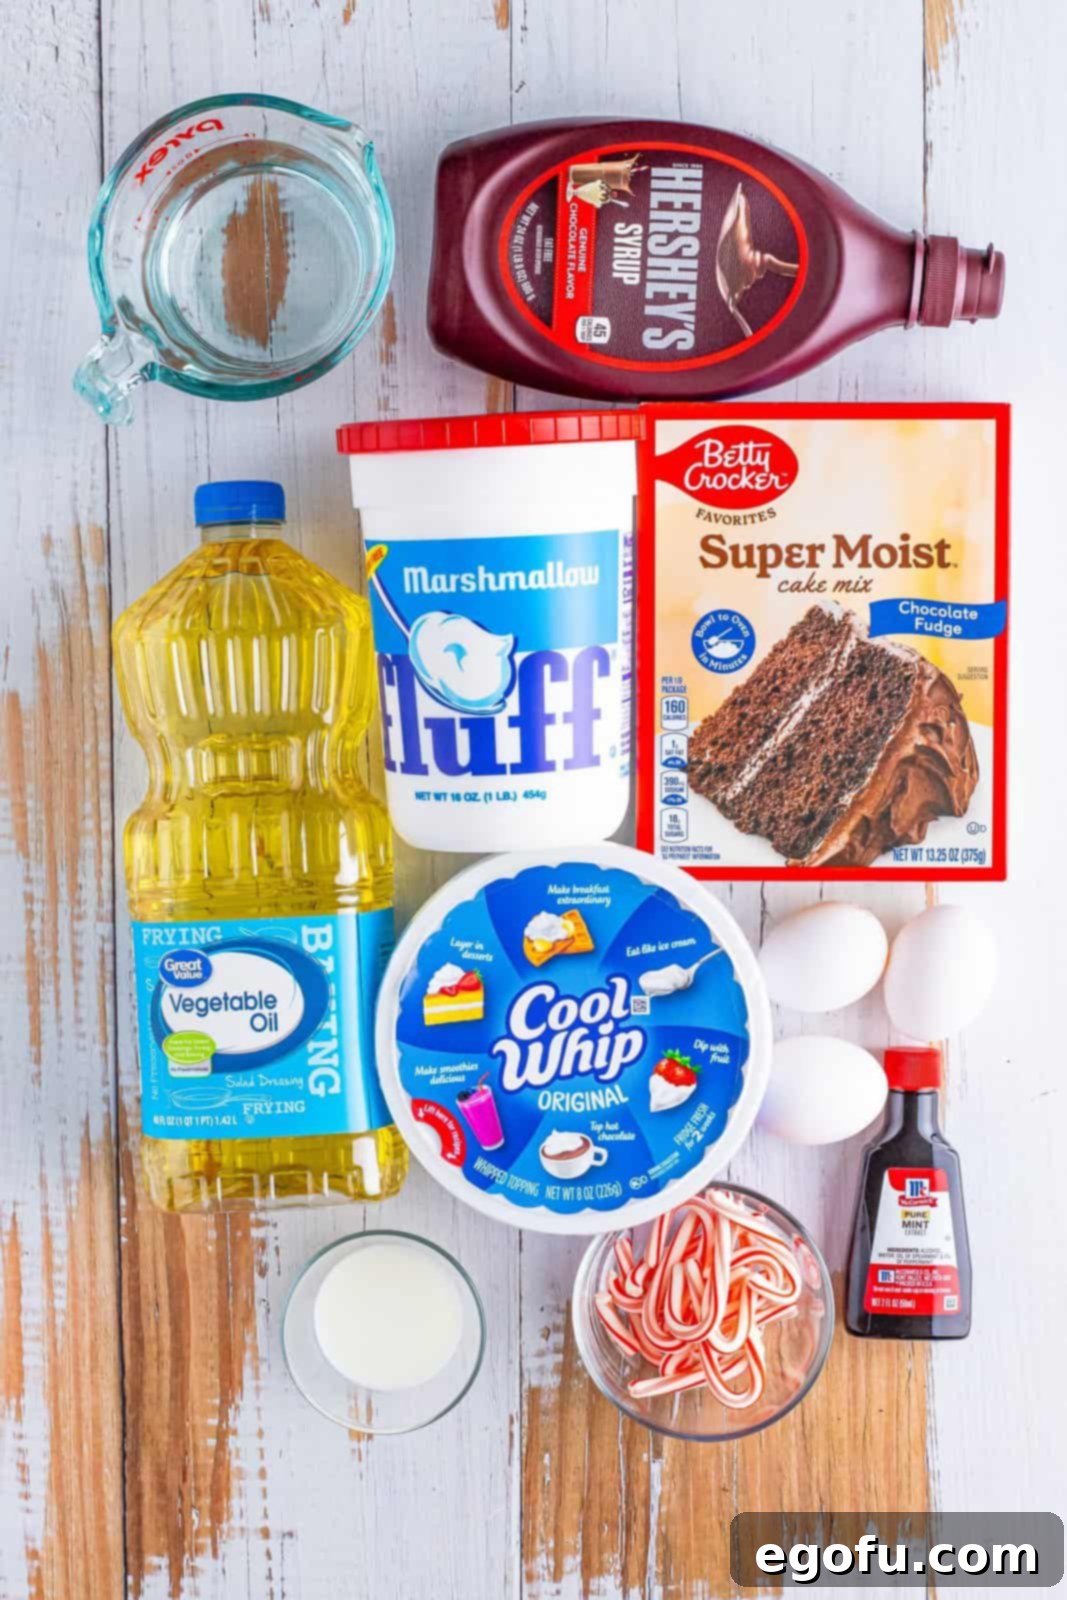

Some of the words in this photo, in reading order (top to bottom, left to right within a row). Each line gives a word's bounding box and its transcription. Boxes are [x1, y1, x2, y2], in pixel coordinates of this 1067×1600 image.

[567, 203, 578, 260] CHOCOLATE
[578, 228, 588, 272] GENUINE
[612, 222, 643, 285] SYRUP
[642, 167, 703, 350] HERSHEY'S
[566, 262, 576, 299] FLAVOR
[593, 323, 607, 337] 45
[695, 438, 772, 473] Betty
[695, 507, 777, 526] FAVORITES
[699, 534, 825, 578] Super
[831, 533, 952, 569] Moist
[777, 572, 827, 593] cake
[833, 575, 873, 593] mix
[898, 601, 979, 621] Chocolate
[695, 614, 717, 638] Bowl
[718, 613, 730, 622] to
[913, 617, 962, 638] Fudge
[698, 653, 708, 668] in
[708, 653, 748, 672] Minutes
[664, 700, 686, 713] 160
[415, 791, 431, 801] NET
[433, 791, 448, 801] WT
[450, 792, 461, 802] 16
[522, 789, 547, 801] 454g
[892, 847, 909, 862] NET
[910, 847, 924, 862] WT
[926, 847, 947, 862] 13.25
[949, 847, 960, 862] OZ
[548, 885, 571, 896] Make
[572, 884, 610, 896] breakfast
[557, 896, 611, 907] extraordinary
[142, 926, 223, 945] FRYING
[449, 937, 474, 951] Layer
[474, 942, 484, 951] in
[462, 950, 493, 963] desserts
[626, 946, 639, 958] Eat
[640, 943, 655, 955] like
[657, 941, 669, 952] ice
[671, 938, 697, 950] cream
[164, 958, 202, 971] Great
[173, 971, 203, 979] Value
[168, 991, 277, 1018] Vegetable
[510, 977, 631, 1040] Cool
[250, 1013, 279, 1033] Oil
[693, 1039, 708, 1051] Dip
[709, 1042, 729, 1053] with
[492, 1021, 644, 1091] Whip
[710, 1053, 730, 1065] fruit
[415, 1065, 436, 1077] Make
[438, 1061, 479, 1074] smoothies
[225, 1075, 255, 1089] Salad
[258, 1075, 303, 1089] Dressing
[430, 1074, 465, 1085] delicious
[537, 1085, 629, 1113] ORIGINAL
[243, 1101, 305, 1115] FRYING
[590, 1122, 603, 1133] Top
[605, 1122, 619, 1131] hot
[691, 1129, 704, 1143] 2
[597, 1131, 636, 1142] chocolate
[473, 1155, 508, 1185] WHIPPED
[506, 1173, 541, 1198] TOPPING
[545, 1185, 561, 1200] NET
[562, 1186, 575, 1200] WT
[576, 1186, 582, 1200] 8
[583, 1185, 594, 1200] OZ
[901, 1220, 929, 1229] MINT
